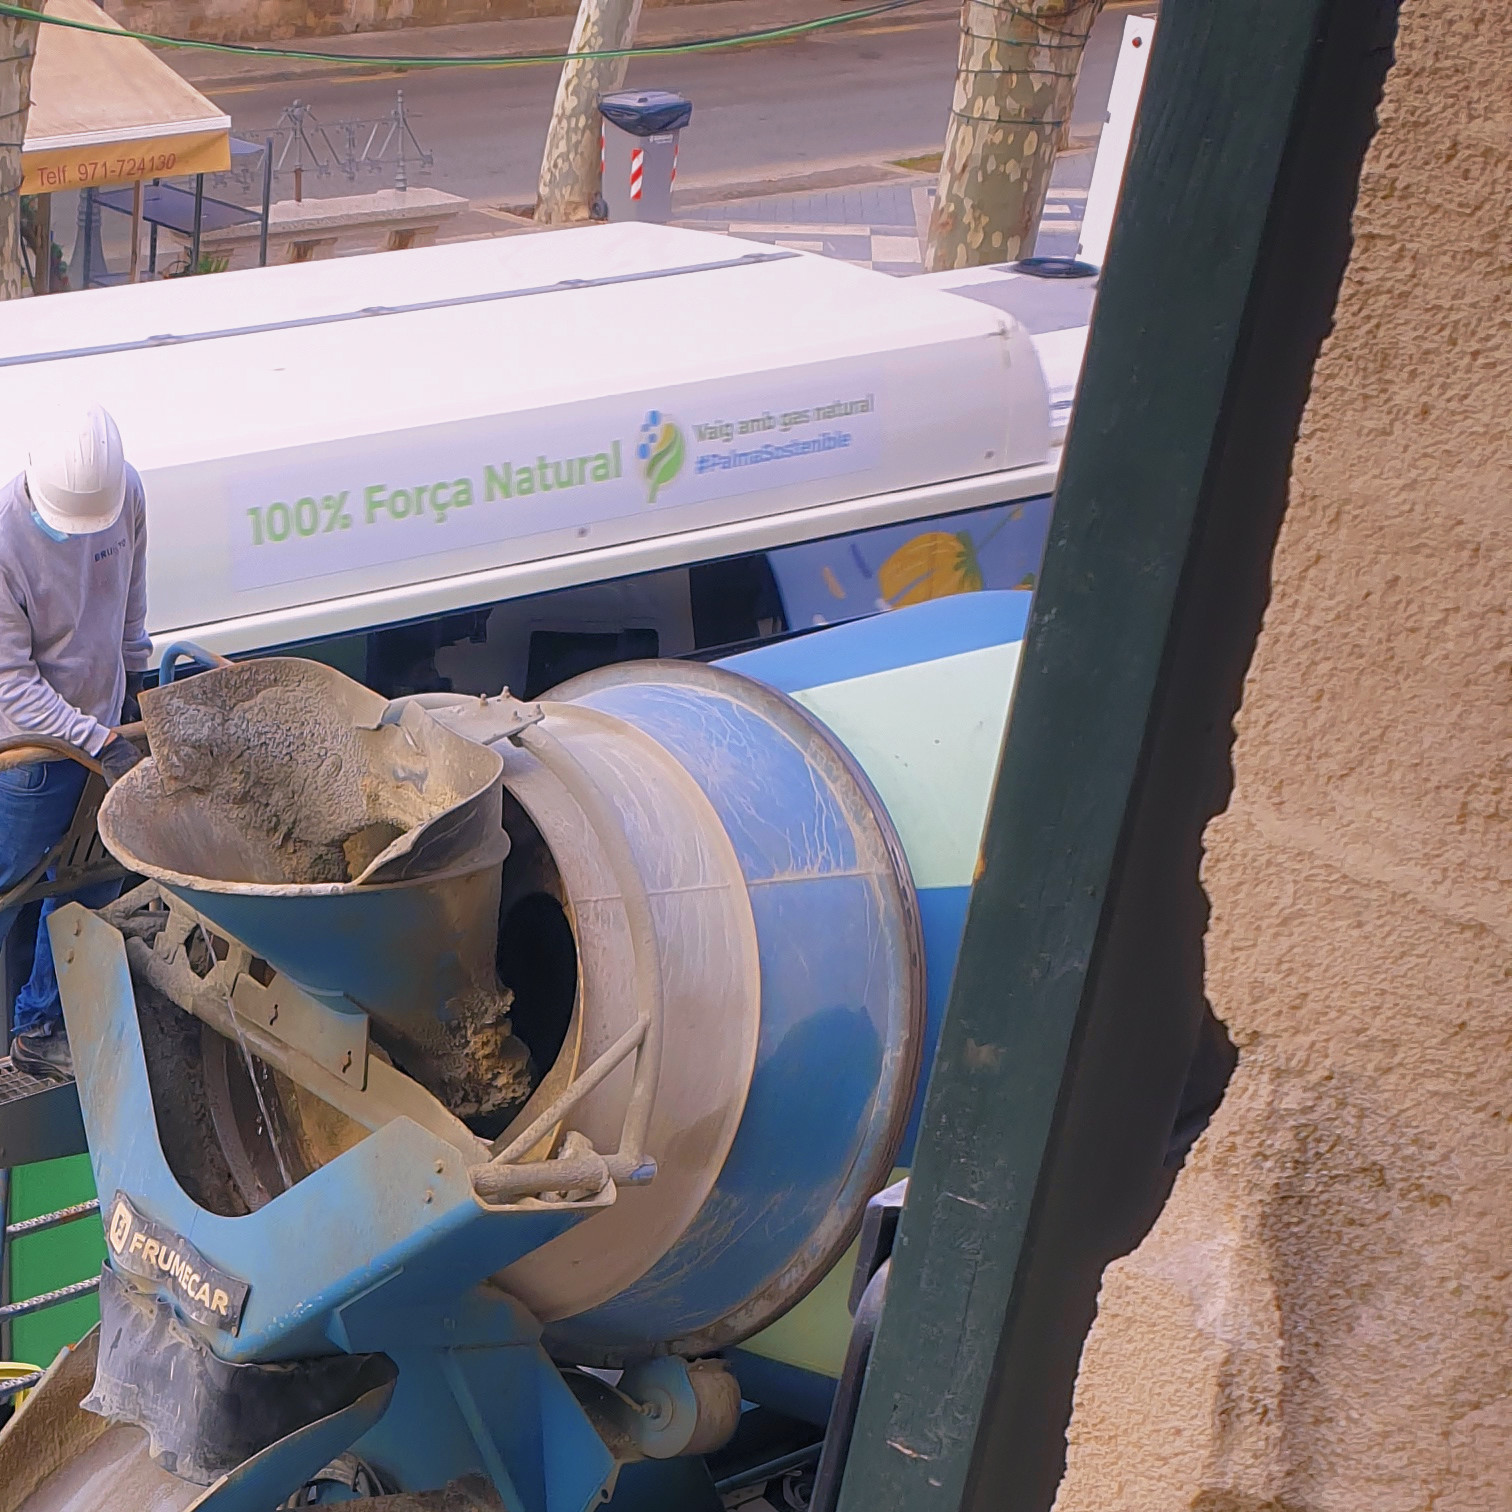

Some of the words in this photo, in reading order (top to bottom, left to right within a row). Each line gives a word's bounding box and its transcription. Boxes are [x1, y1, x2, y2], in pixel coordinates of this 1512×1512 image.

[38, 165, 72, 187] Telf.
[78, 153, 176, 182] 971-724130
[692, 419, 734, 443] Vaig
[737, 411, 776, 436] amb
[779, 408, 810, 432] gas
[813, 393, 875, 422] natural
[247, 490, 353, 546] 100%
[363, 477, 474, 524] Força
[483, 440, 622, 502] Natural
[128, 1231, 229, 1316] FRUMECAR
